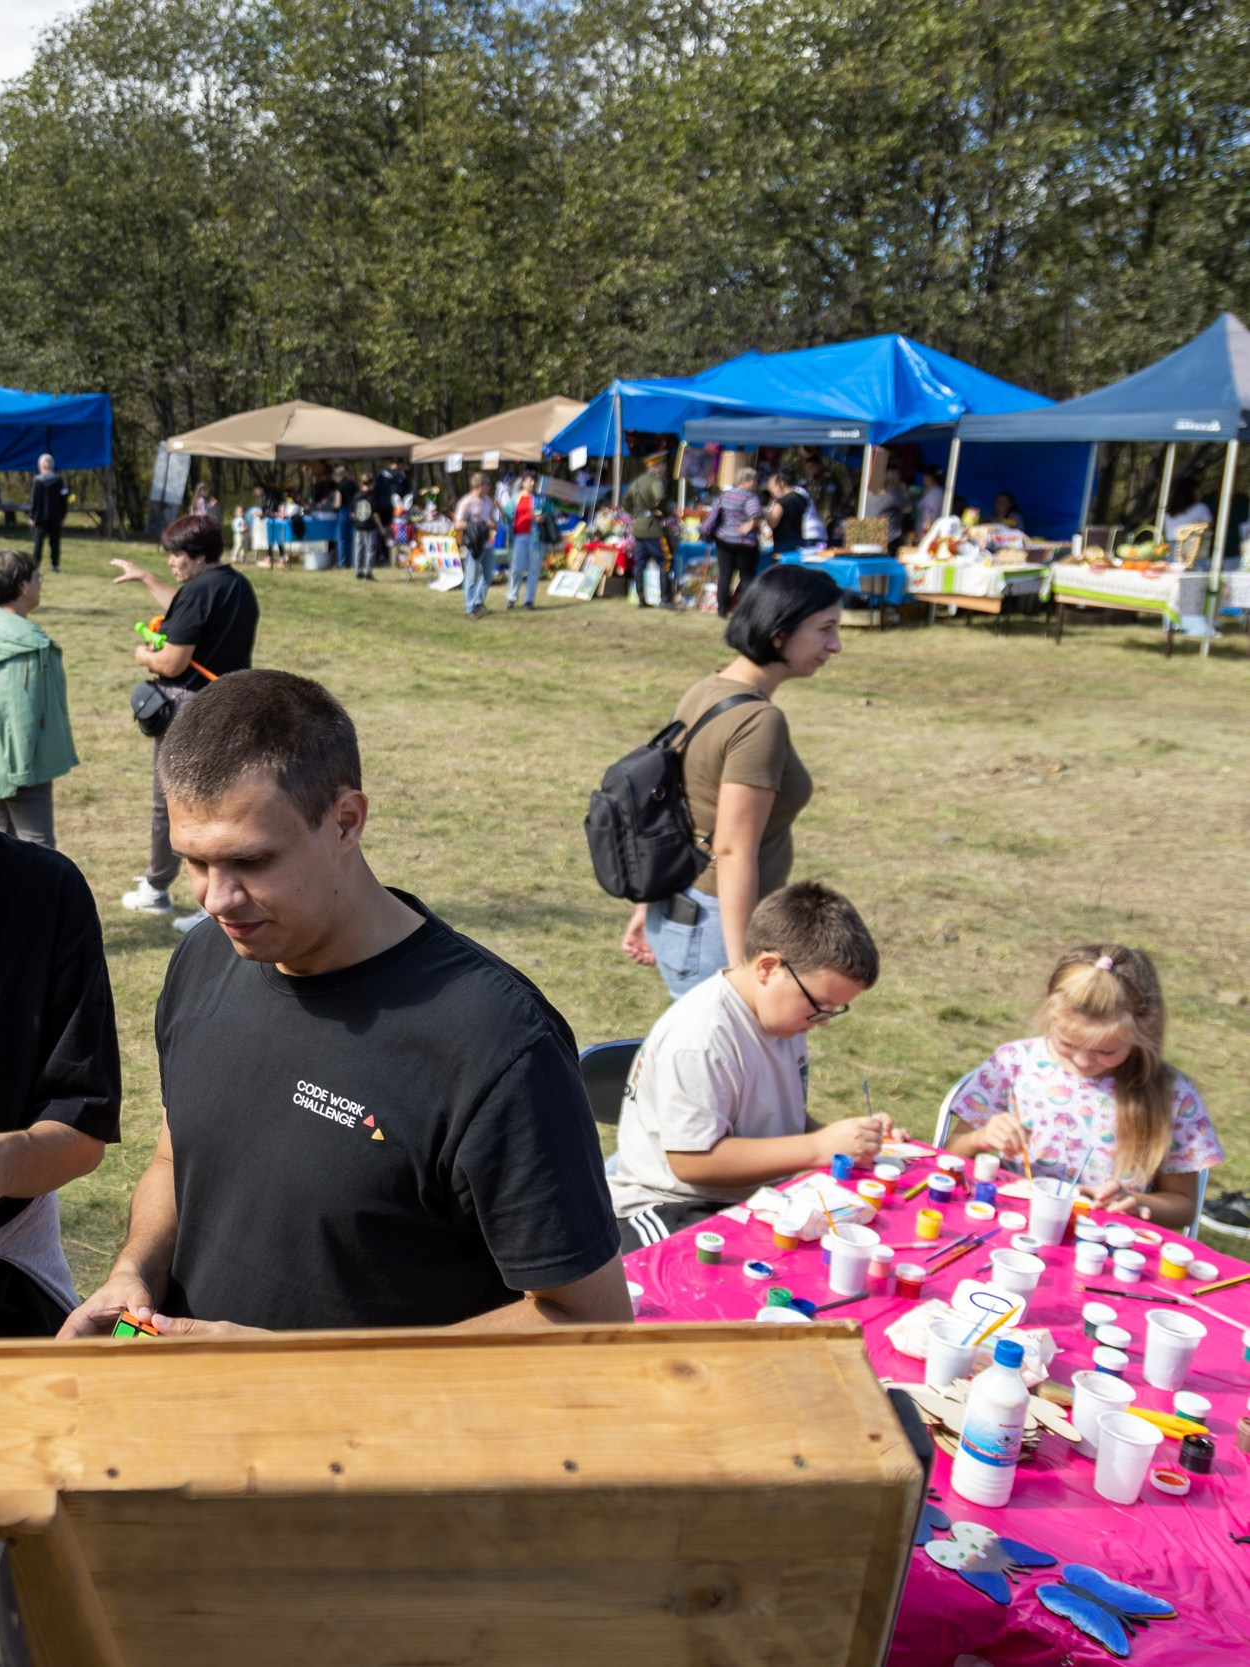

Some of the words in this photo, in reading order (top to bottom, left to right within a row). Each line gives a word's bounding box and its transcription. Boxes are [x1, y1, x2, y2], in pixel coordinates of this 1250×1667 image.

[292, 1092, 357, 1129] CHALLENGE
[296, 1080, 330, 1102] CODE
[330, 1092, 366, 1118] WORK
